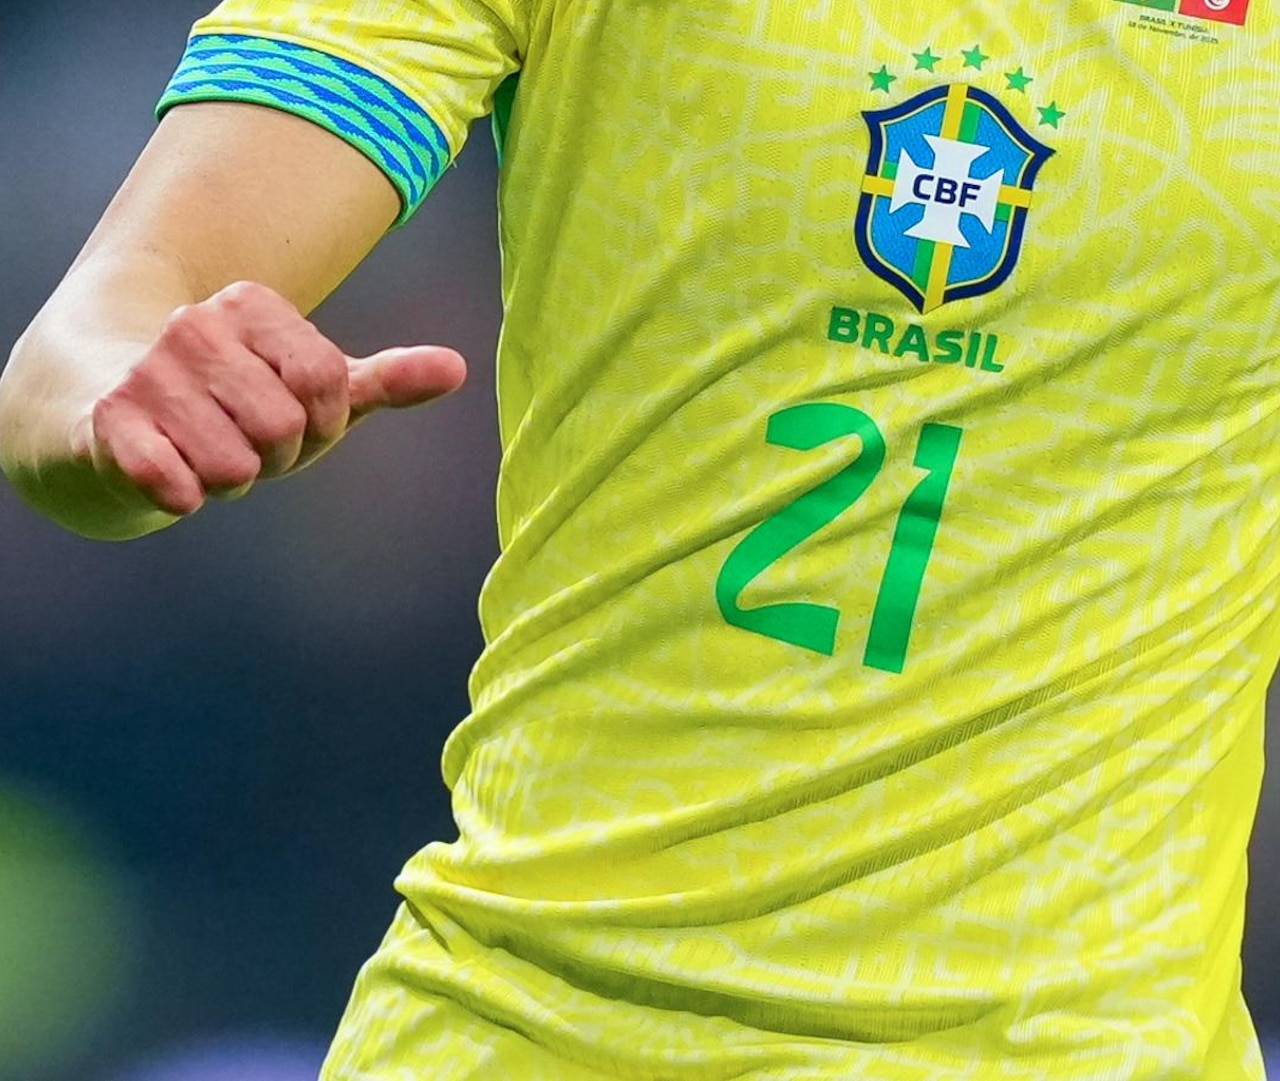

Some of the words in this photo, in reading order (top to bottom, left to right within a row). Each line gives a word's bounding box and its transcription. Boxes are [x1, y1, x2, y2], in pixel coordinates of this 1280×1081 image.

[913, 174, 981, 208] CBF
[827, 306, 1005, 373] BRASIL
[716, 402, 963, 674] 21
